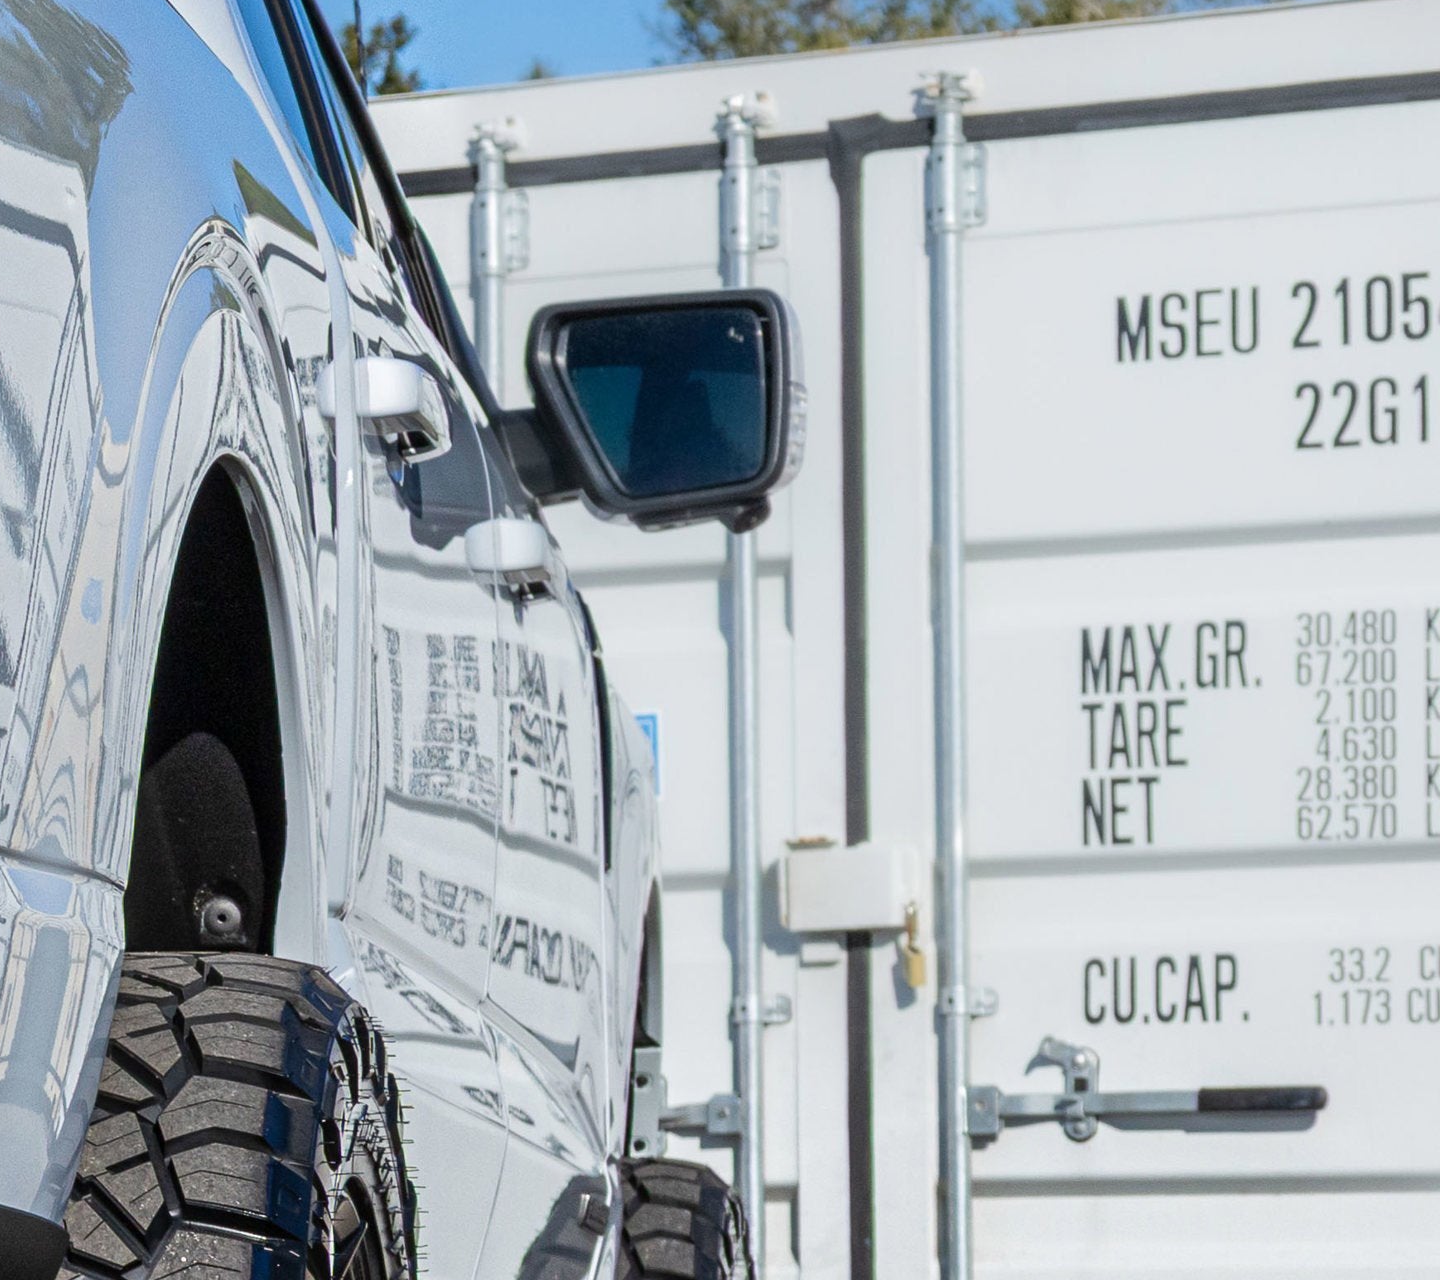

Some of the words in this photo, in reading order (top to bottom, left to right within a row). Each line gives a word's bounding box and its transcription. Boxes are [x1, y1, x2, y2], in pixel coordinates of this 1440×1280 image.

[1117, 287, 1258, 362] MSEU
[1292, 272, 1440, 348] 2105
[1296, 375, 1428, 449] 22G1
[1297, 610, 1396, 646] 30.480
[1082, 621, 1260, 693] MAX.GR.
[1297, 650, 1396, 685] 67.200
[1317, 690, 1396, 724] 2.100
[1082, 700, 1187, 769] TARE
[1317, 727, 1396, 761] 4.630
[1298, 766, 1396, 800] 28.380
[1083, 777, 1159, 845] NET
[1298, 804, 1396, 840] 62.570
[1329, 947, 1390, 983] 33.2
[1420, 946, 1440, 980] C
[1085, 954, 1248, 1025] CU.CAP.
[1315, 989, 1390, 1025] 1.173
